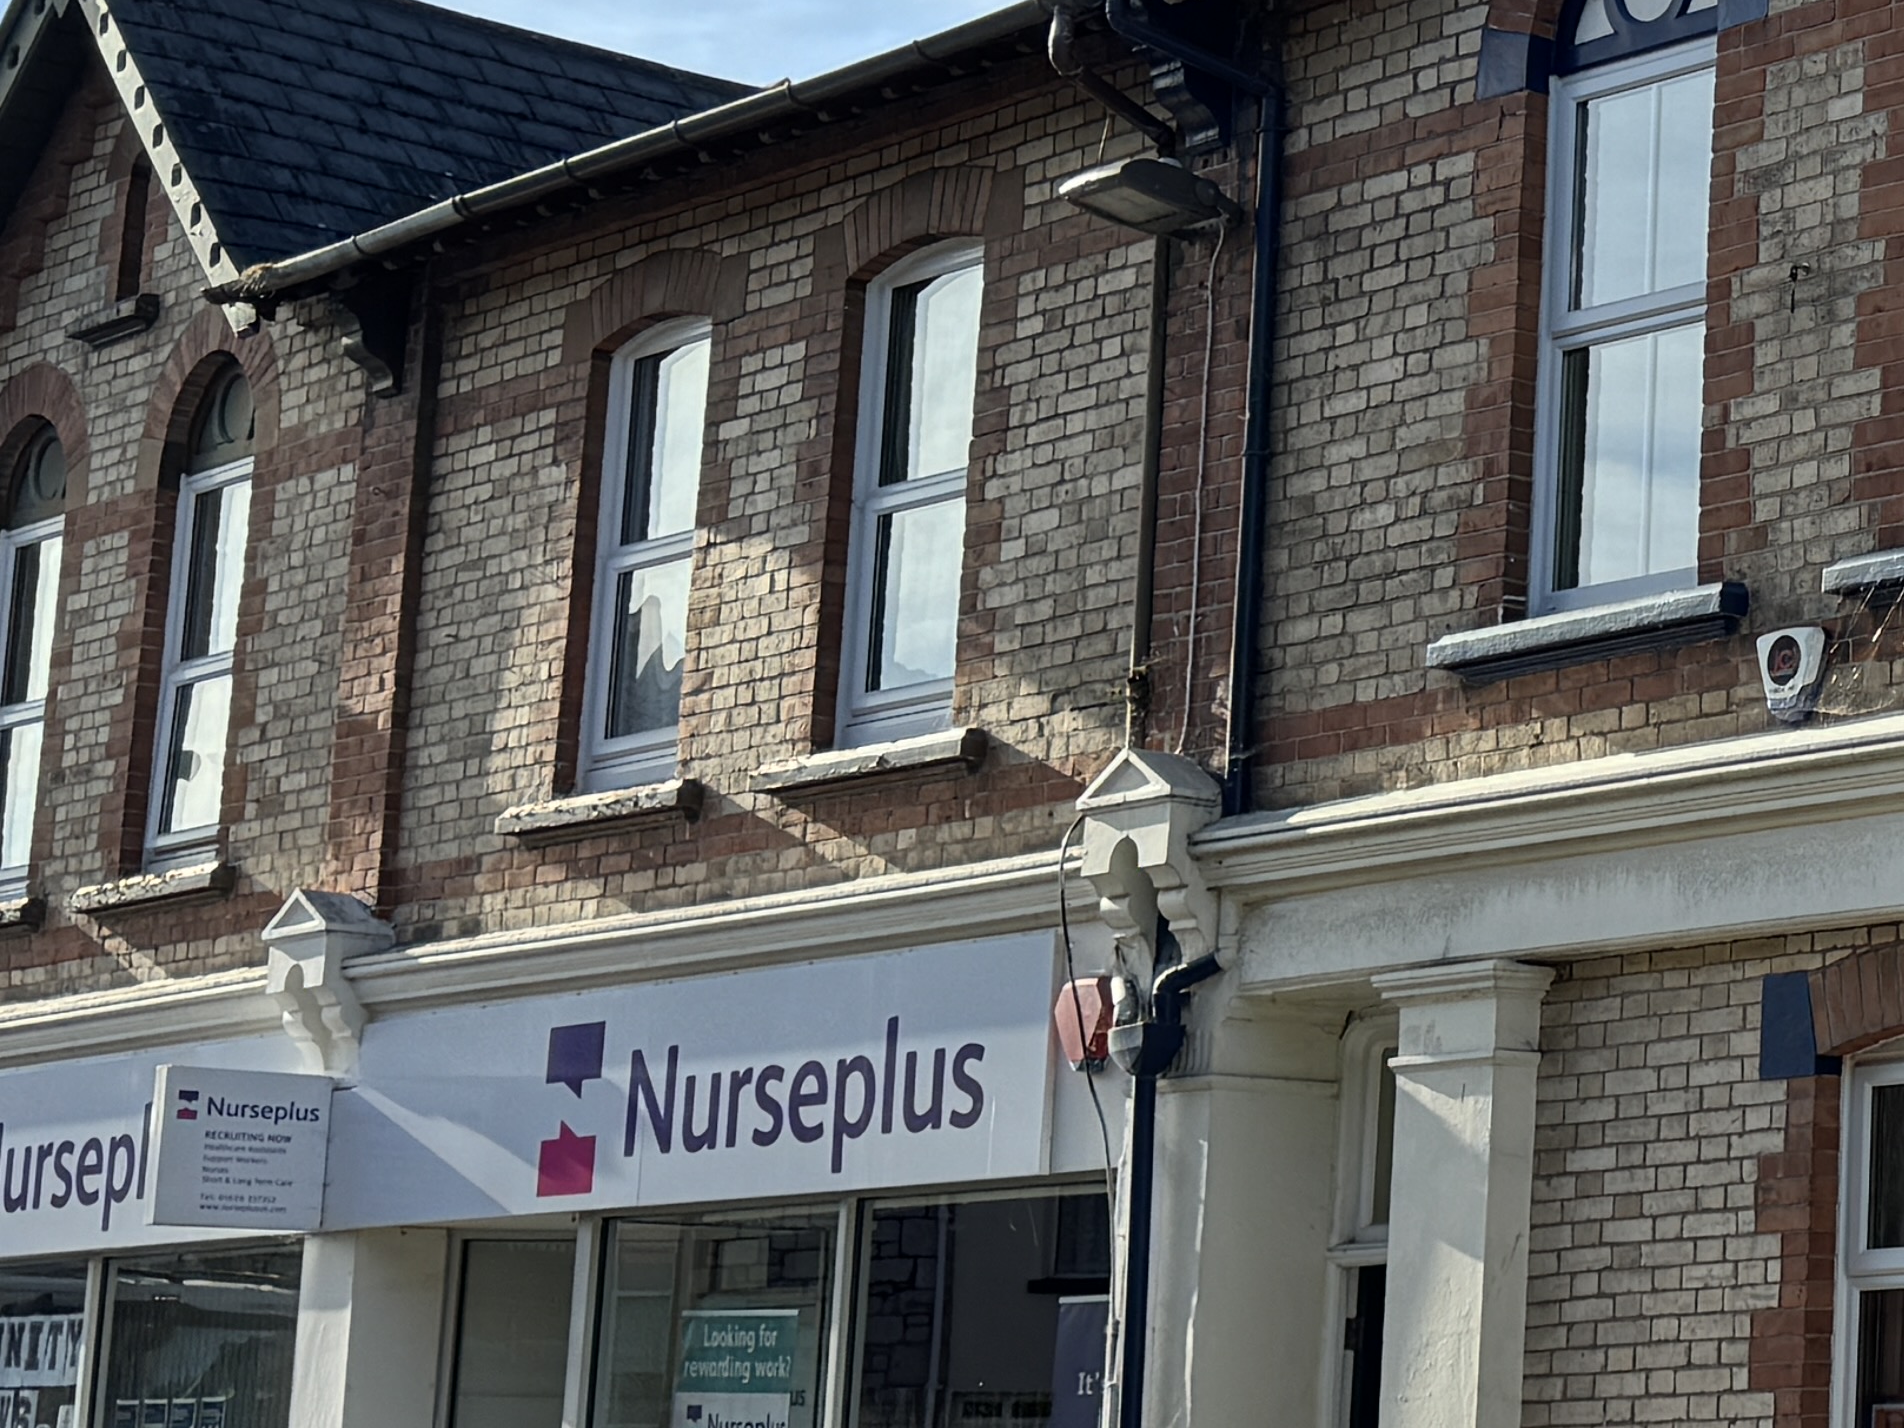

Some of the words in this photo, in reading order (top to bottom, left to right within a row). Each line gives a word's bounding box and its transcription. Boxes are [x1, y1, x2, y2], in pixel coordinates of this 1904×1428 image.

[623, 1016, 986, 1174] Nurseplus
[207, 1096, 320, 1125] Nurseplus
[205, 1130, 265, 1143] RECRUITING
[267, 1133, 292, 1144] NOW
[0, 1102, 153, 1232] ursepl
[0, 1319, 83, 1371] NITY
[703, 1324, 755, 1353] Looking
[759, 1323, 778, 1347] for
[683, 1356, 750, 1384] rewarding
[755, 1356, 792, 1378] work?
[1077, 1372, 1104, 1396] It'
